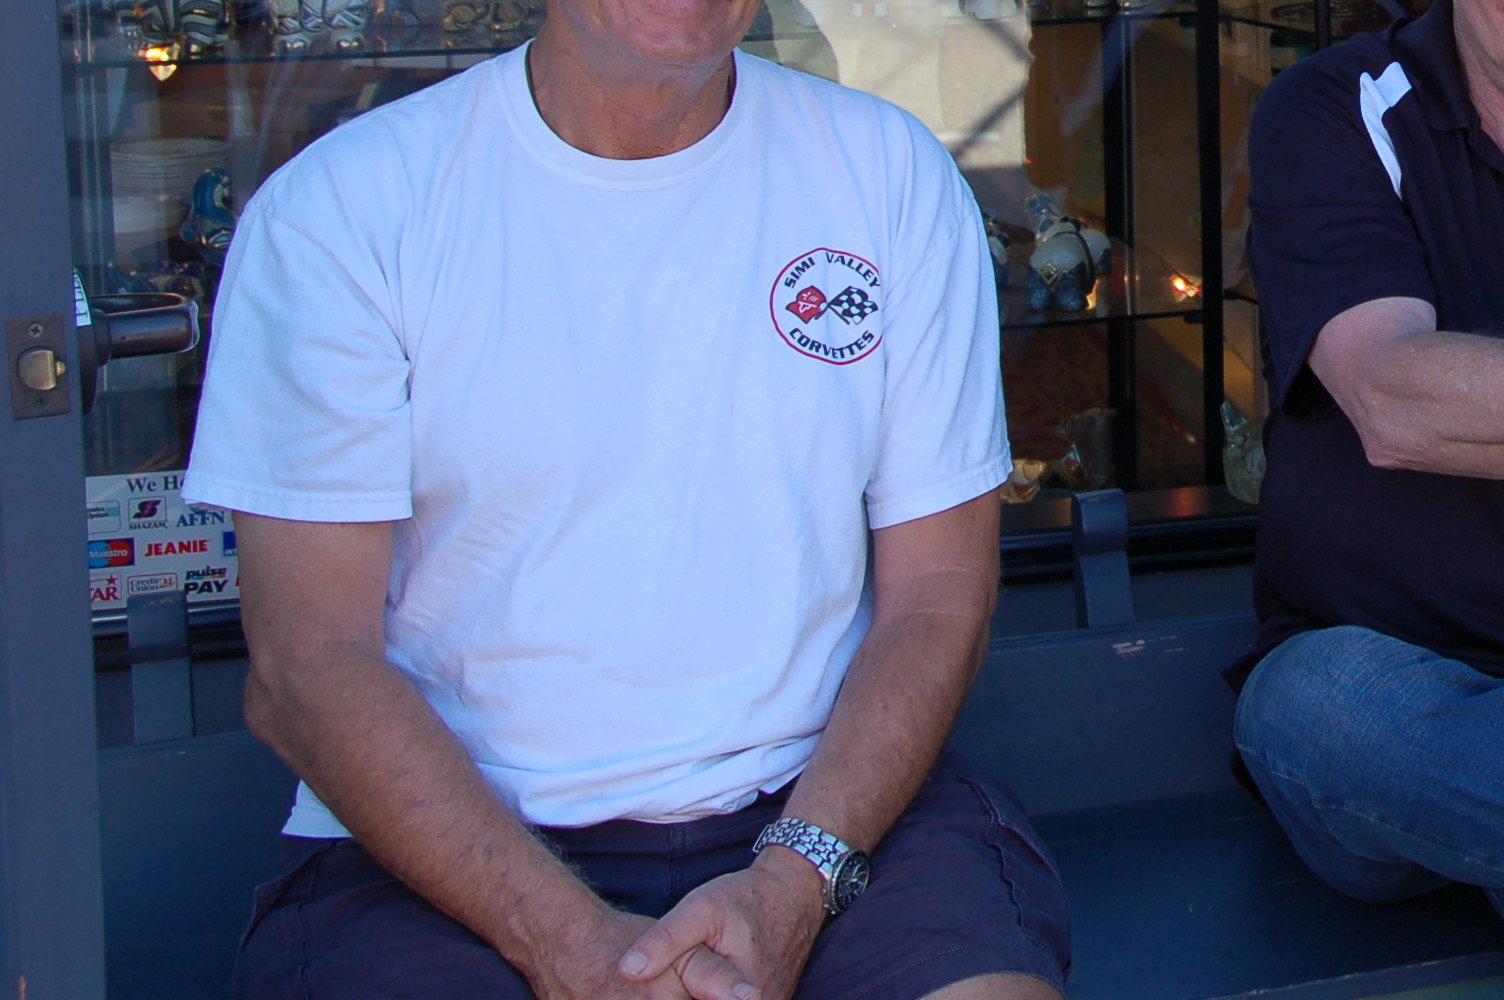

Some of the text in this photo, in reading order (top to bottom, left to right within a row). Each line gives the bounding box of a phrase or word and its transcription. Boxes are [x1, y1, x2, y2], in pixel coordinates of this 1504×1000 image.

[784, 252, 881, 289] SIMI VALLEY
[789, 327, 875, 360] CORVETTES
[126, 477, 157, 493] We
[176, 510, 225, 528] AFFN
[144, 539, 208, 557] JEANIE
[185, 565, 228, 580] pulse
[184, 579, 229, 595] PAY
